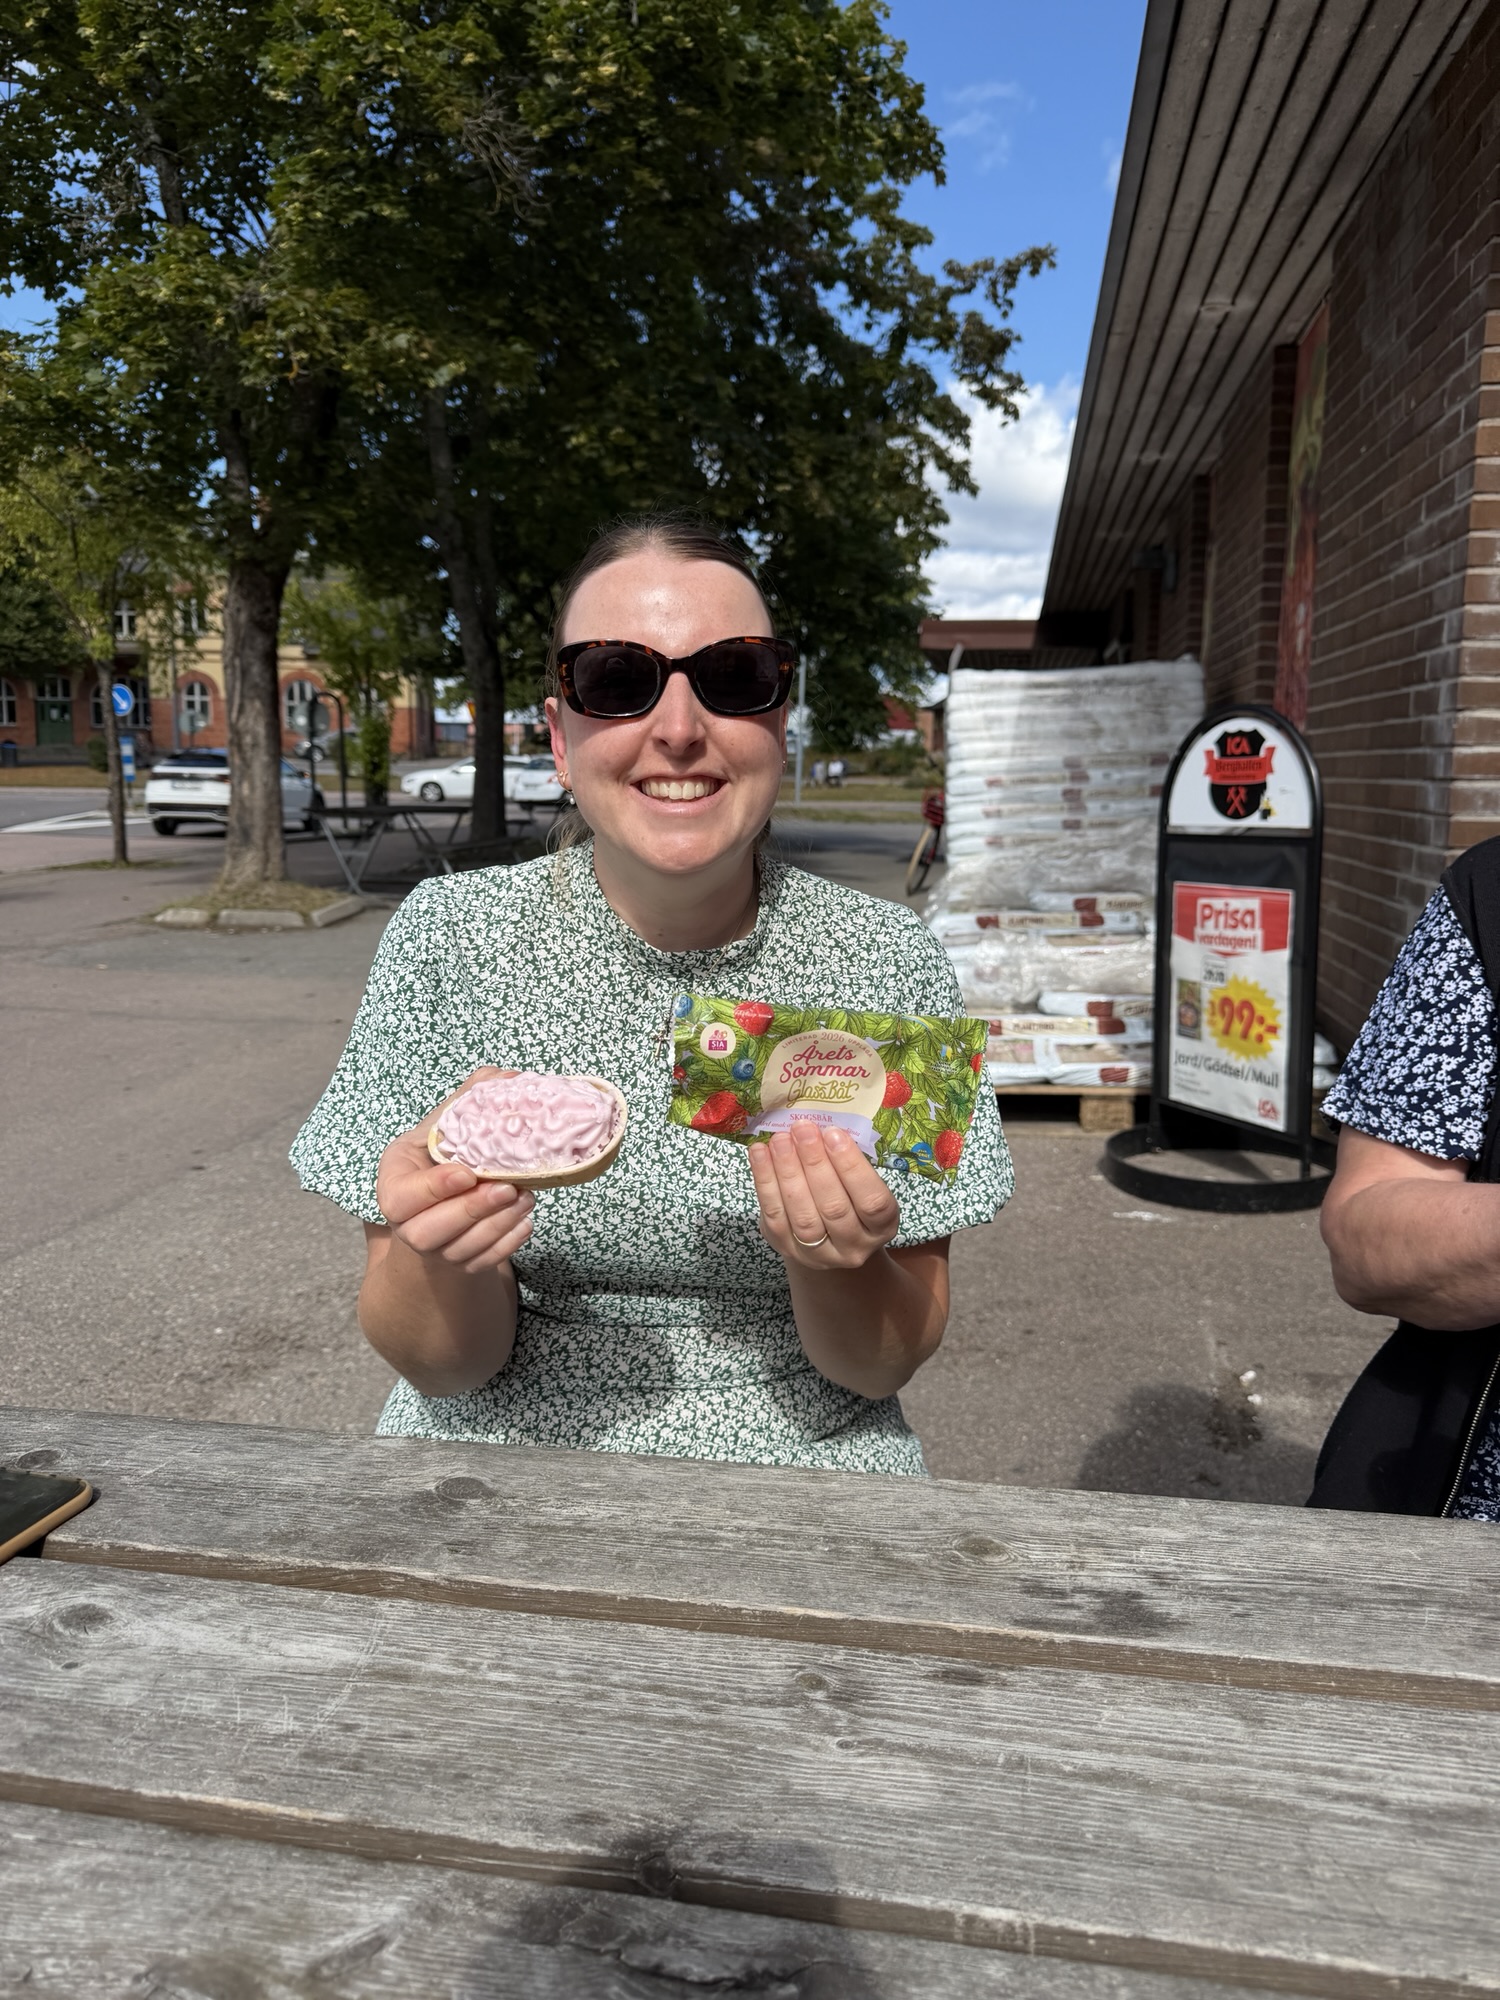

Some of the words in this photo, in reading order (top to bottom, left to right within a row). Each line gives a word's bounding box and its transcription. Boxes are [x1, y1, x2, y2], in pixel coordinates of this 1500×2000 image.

[1226, 736, 1251, 755] ICA
[1201, 902, 1256, 930] Prisa
[711, 1040, 725, 1048] SIA
[782, 1034, 818, 1049] LIMITERAD
[821, 1032, 845, 1043] 2026
[848, 1039, 873, 1058] UPPLAGA
[793, 1040, 857, 1065] Årets
[779, 1062, 870, 1083] Sommar
[789, 1113, 833, 1123] SKOGSBÄR
